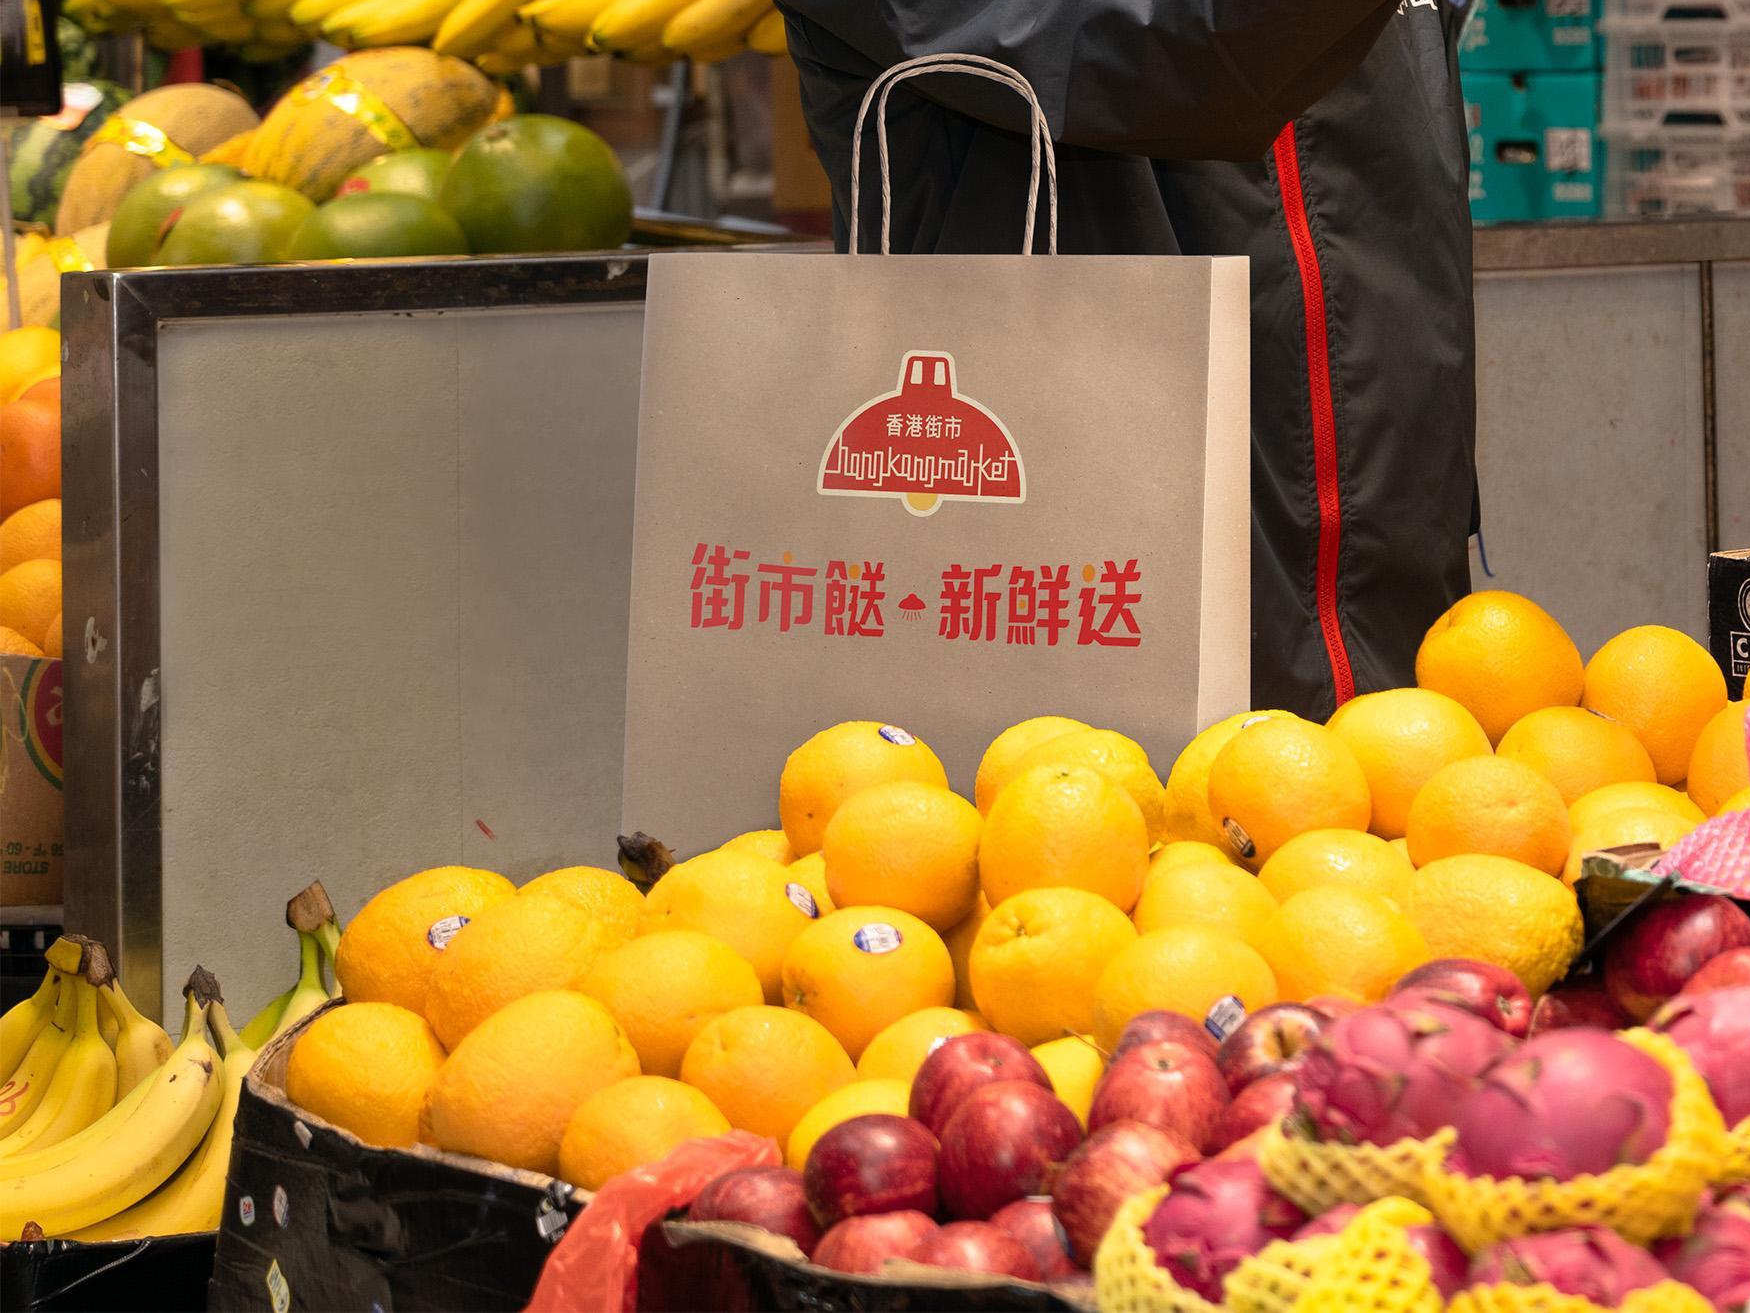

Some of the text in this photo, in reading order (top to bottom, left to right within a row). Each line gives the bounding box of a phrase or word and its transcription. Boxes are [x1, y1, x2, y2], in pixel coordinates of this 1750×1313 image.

[885, 413, 963, 440] 香港街市
[688, 542, 1142, 647] 街市餸 新鮮送
